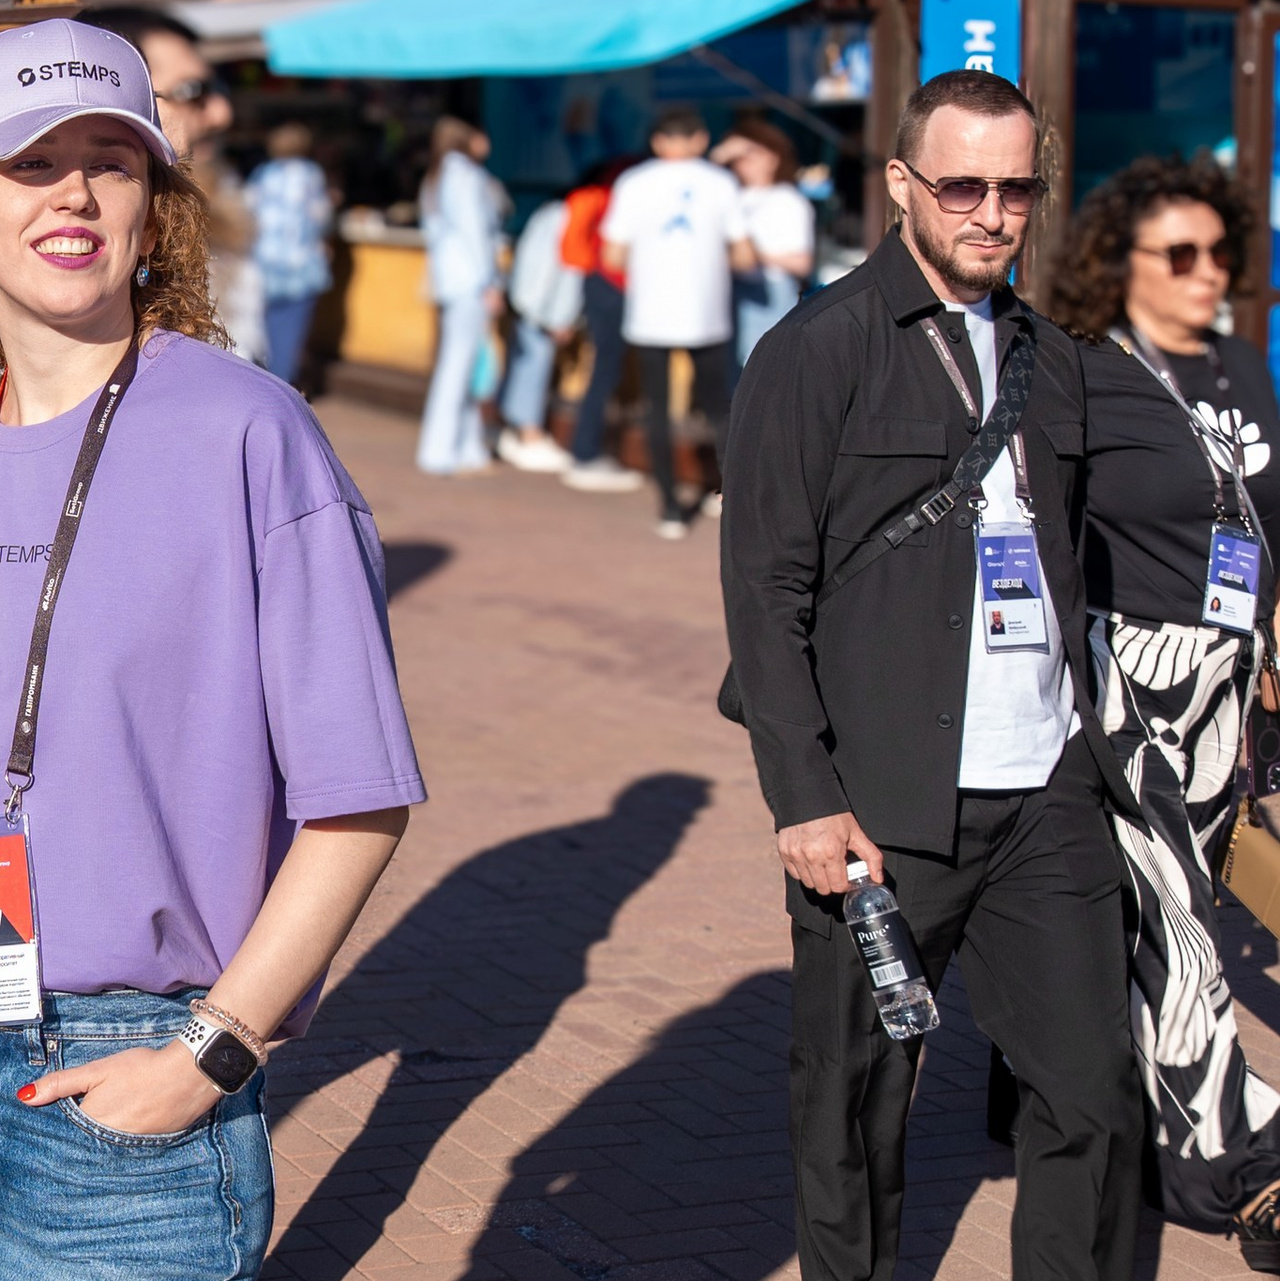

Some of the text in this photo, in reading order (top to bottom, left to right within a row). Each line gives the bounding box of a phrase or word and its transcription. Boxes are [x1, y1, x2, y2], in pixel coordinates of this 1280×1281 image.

[40, 61, 121, 88] STEMPS
[97, 395, 117, 434] ДВИЖЕНИЕ
[44, 578, 55, 601] Avito
[24, 664, 39, 717] ГАЗПРОМБАНК
[857, 928, 887, 944] Pure
